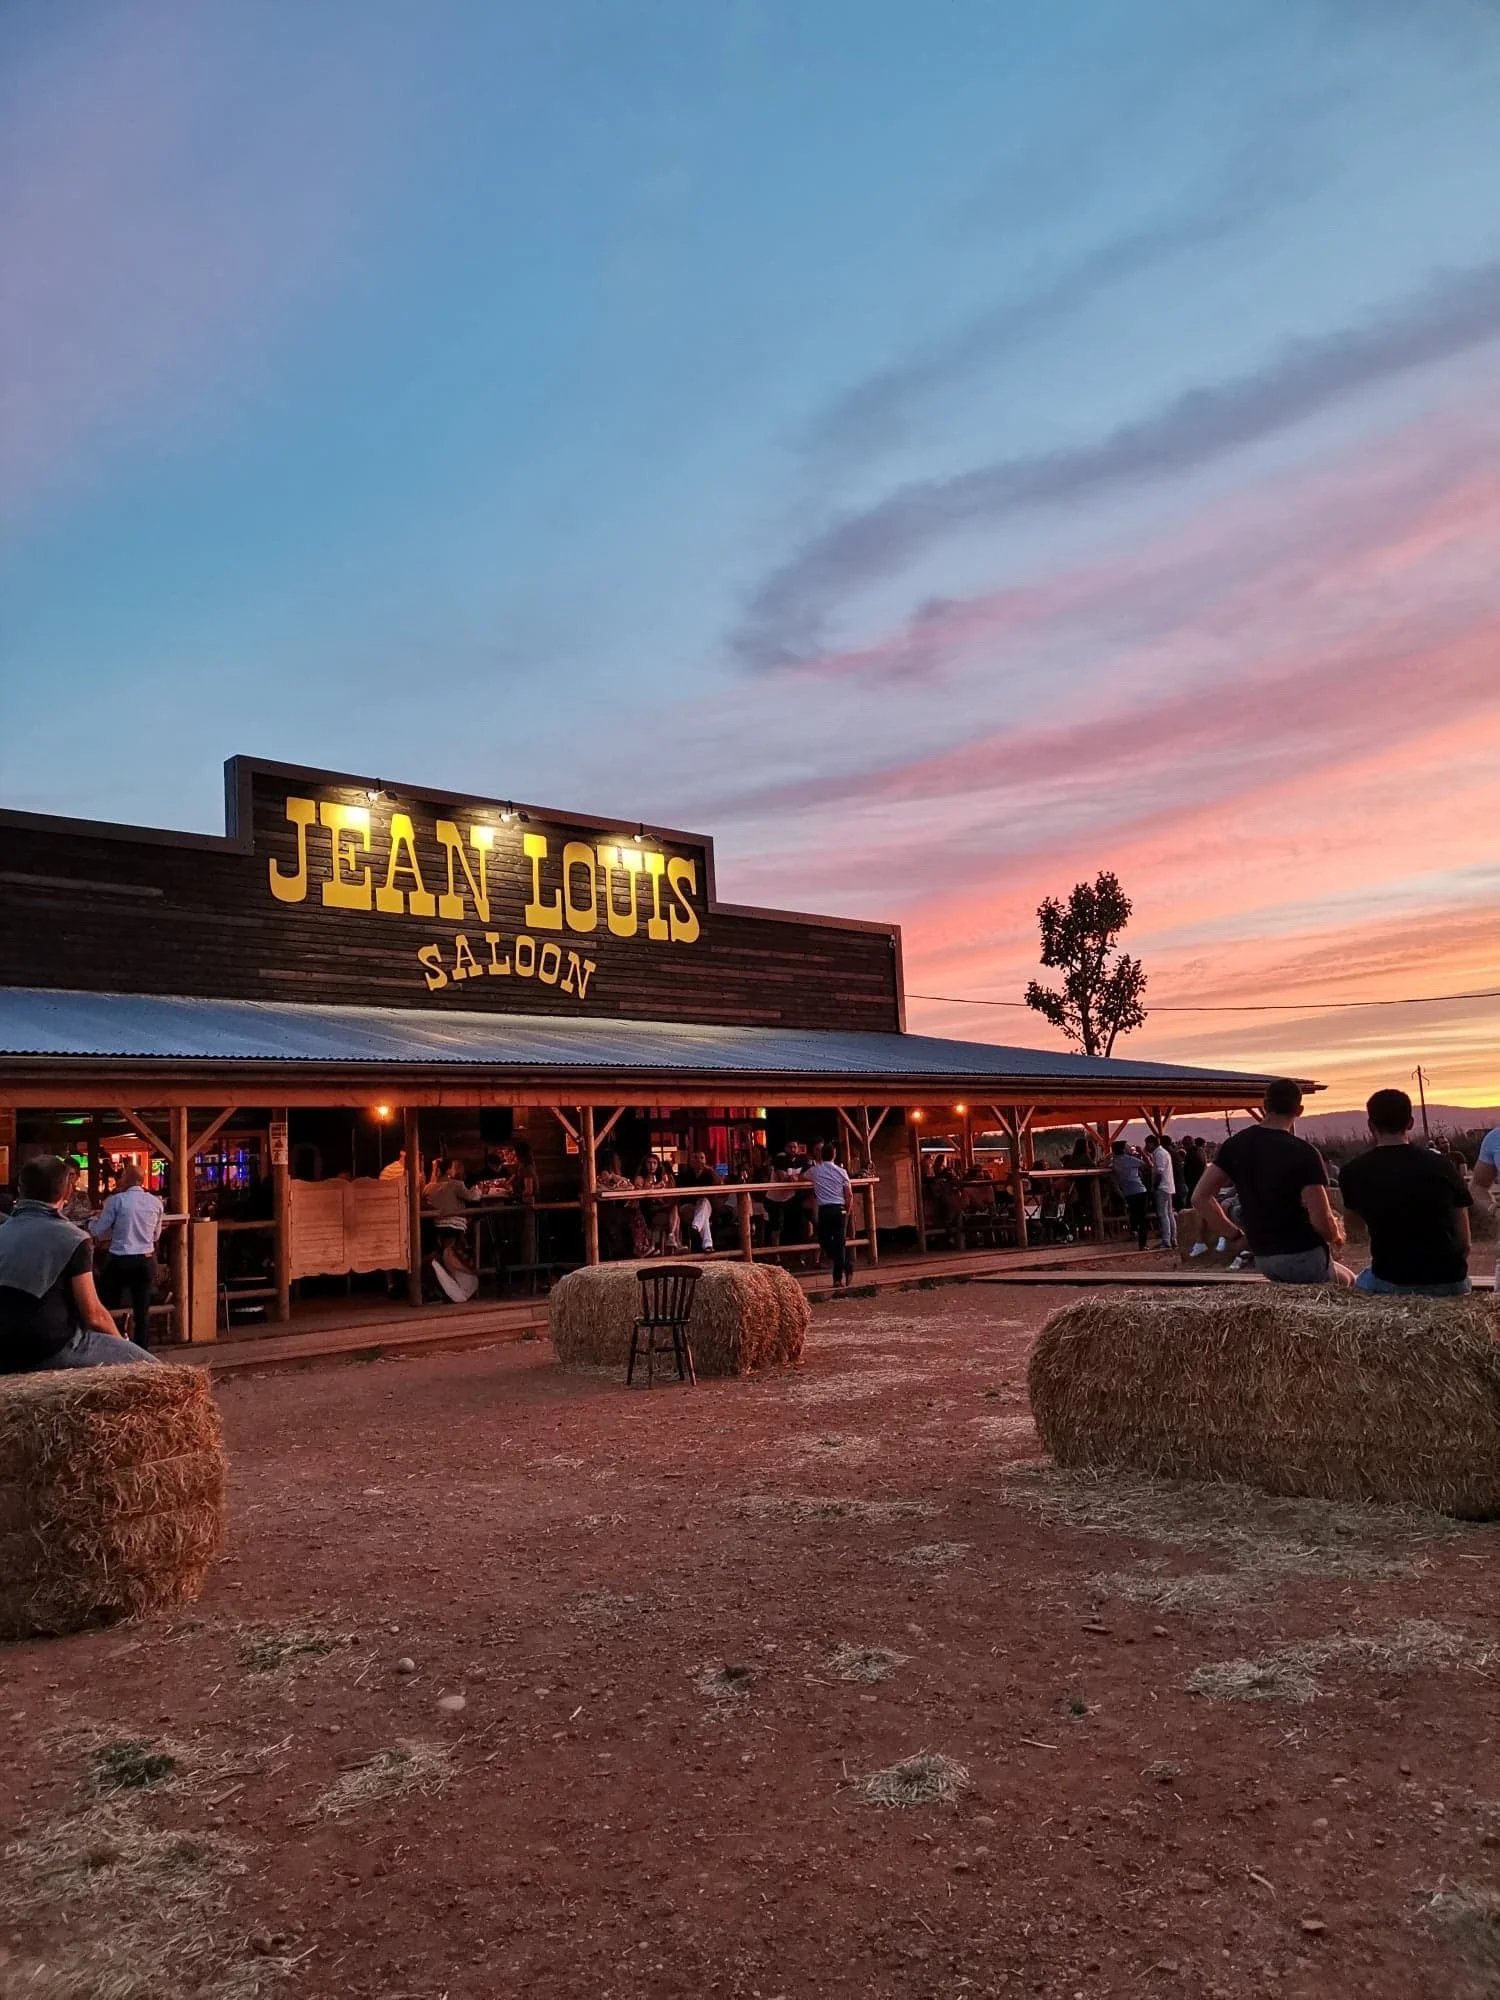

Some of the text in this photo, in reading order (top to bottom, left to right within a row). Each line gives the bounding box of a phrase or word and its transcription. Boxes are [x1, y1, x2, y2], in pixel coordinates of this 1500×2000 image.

[269, 797, 700, 944] JEAN LOUIS
[417, 932, 596, 999] SALOON
